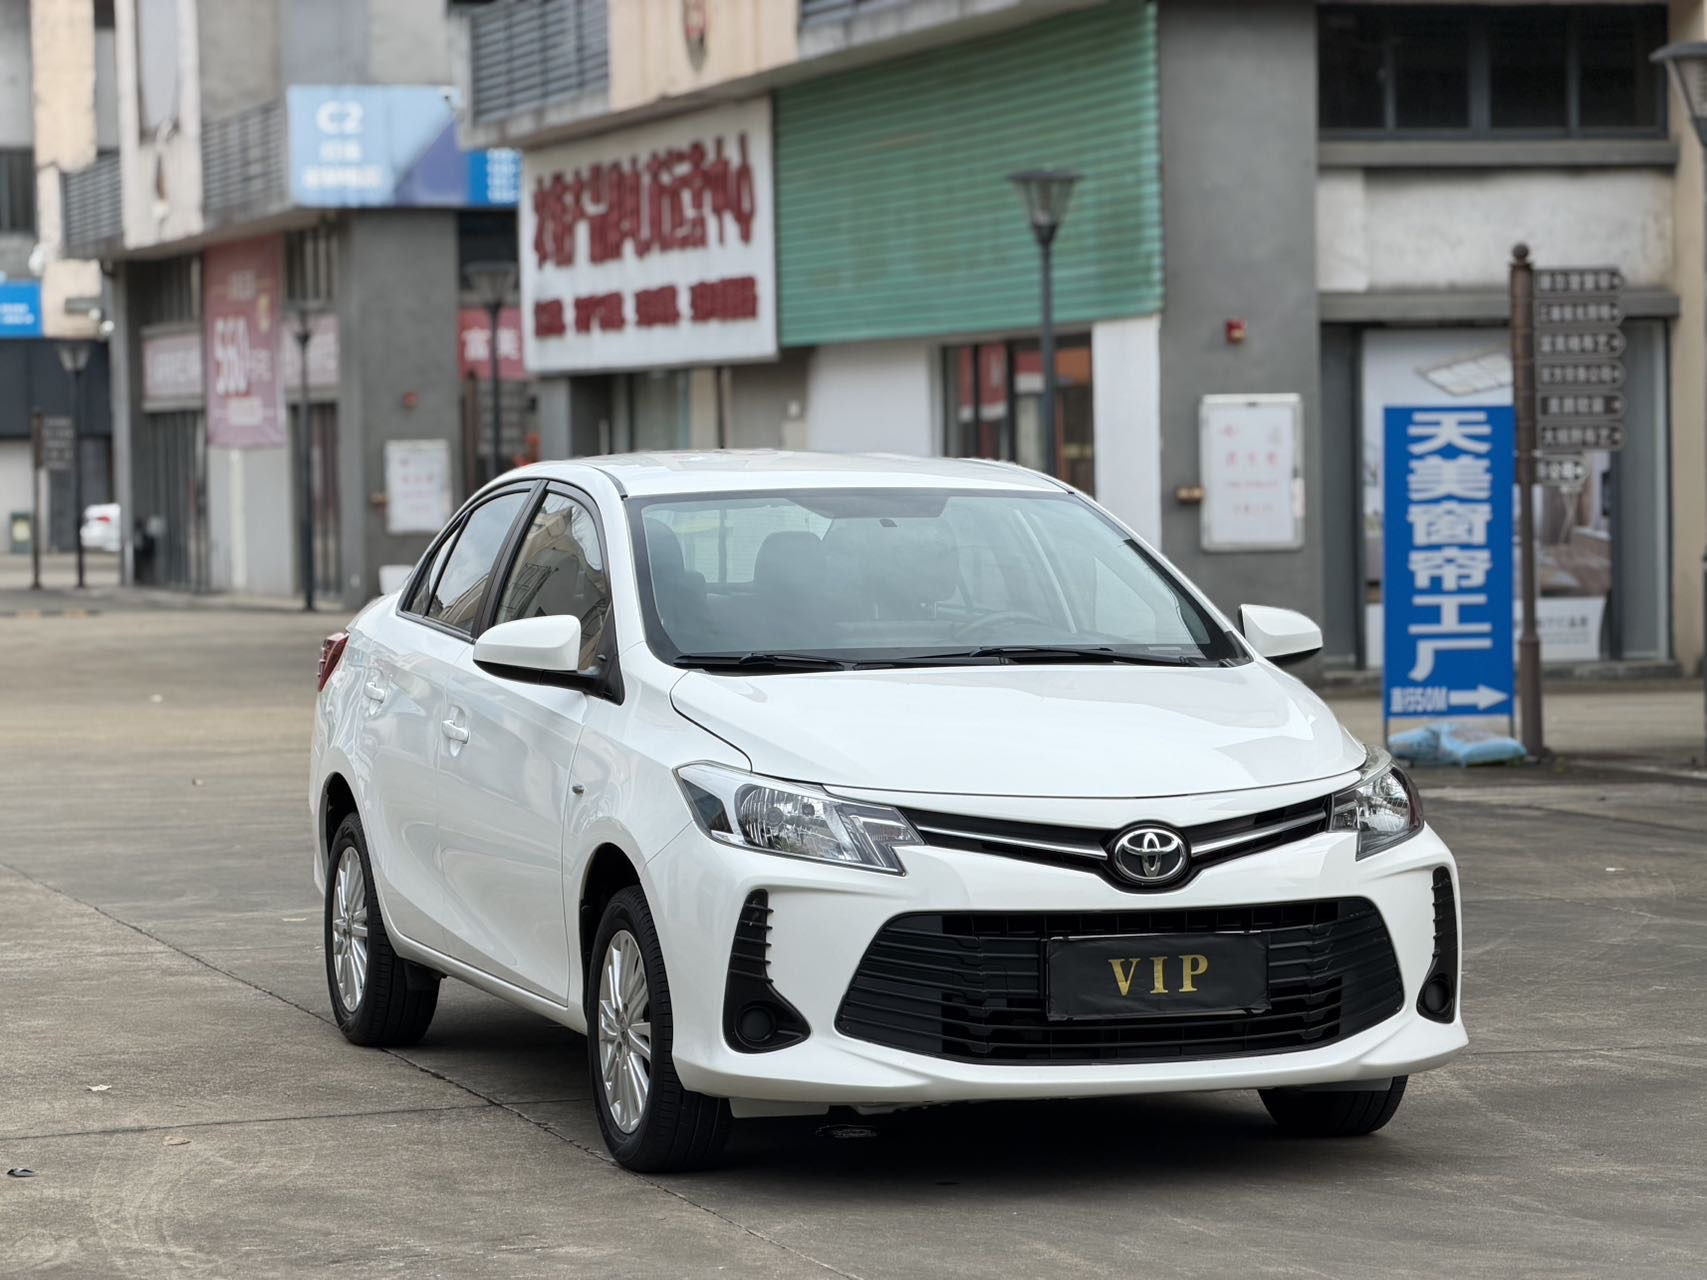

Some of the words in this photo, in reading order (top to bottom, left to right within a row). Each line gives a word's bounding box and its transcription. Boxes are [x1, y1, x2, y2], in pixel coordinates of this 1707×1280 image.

[1407, 411, 1492, 682] 天美窗帘工厂
[1108, 954, 1209, 996] VIP
